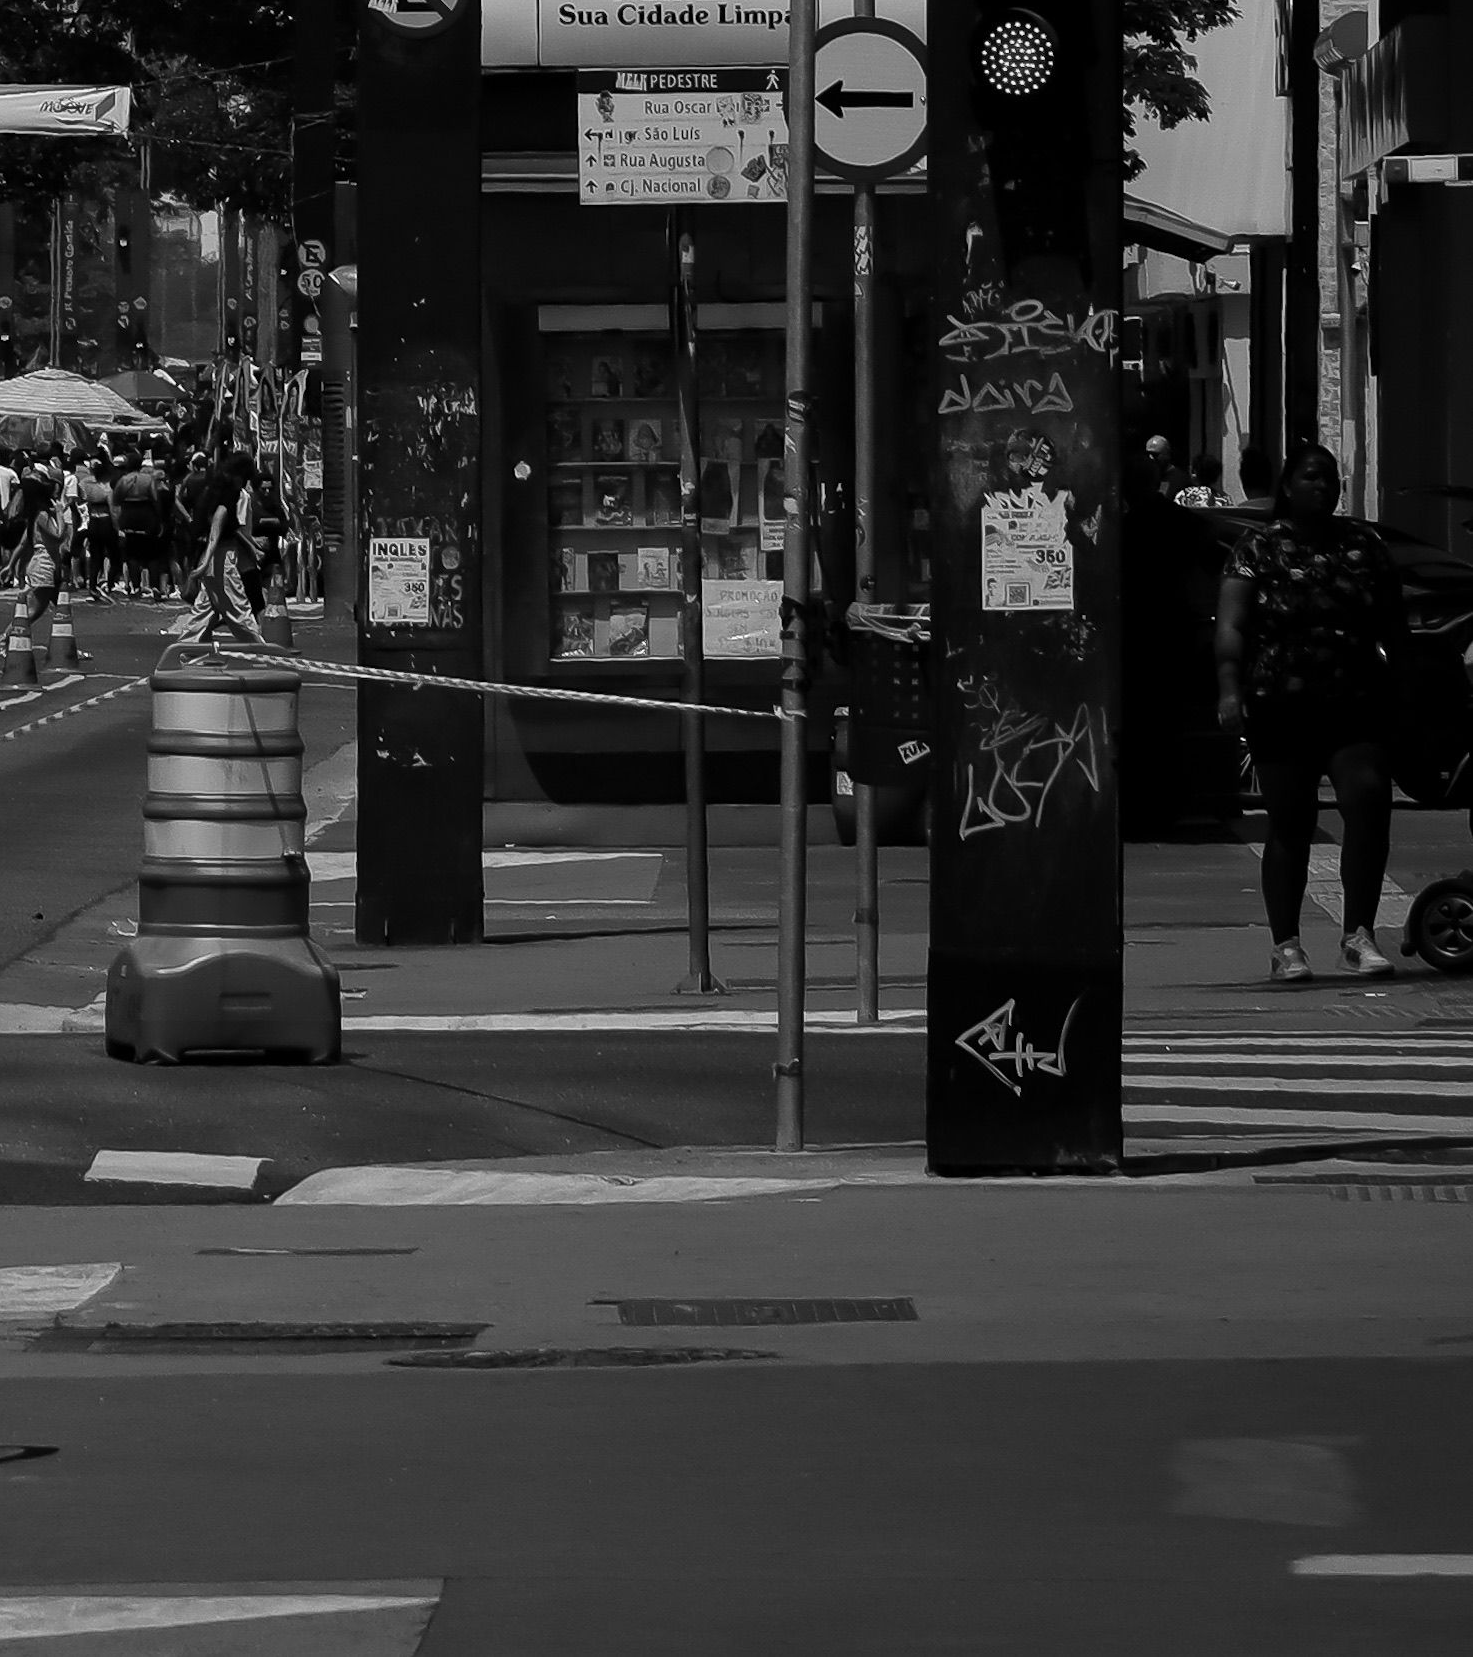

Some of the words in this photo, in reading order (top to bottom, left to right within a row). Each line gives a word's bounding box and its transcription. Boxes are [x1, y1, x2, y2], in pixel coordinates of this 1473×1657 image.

[558, 3, 608, 26] Sua
[617, 3, 709, 26] Cidade
[649, 73, 719, 89] PEDESTRE
[644, 100, 672, 115] Rua
[674, 100, 712, 115] Oscar
[644, 127, 669, 141] São
[672, 127, 701, 141] Luís
[619, 153, 646, 168] Rua
[649, 153, 706, 172] Augusta
[642, 179, 701, 194] Nacional
